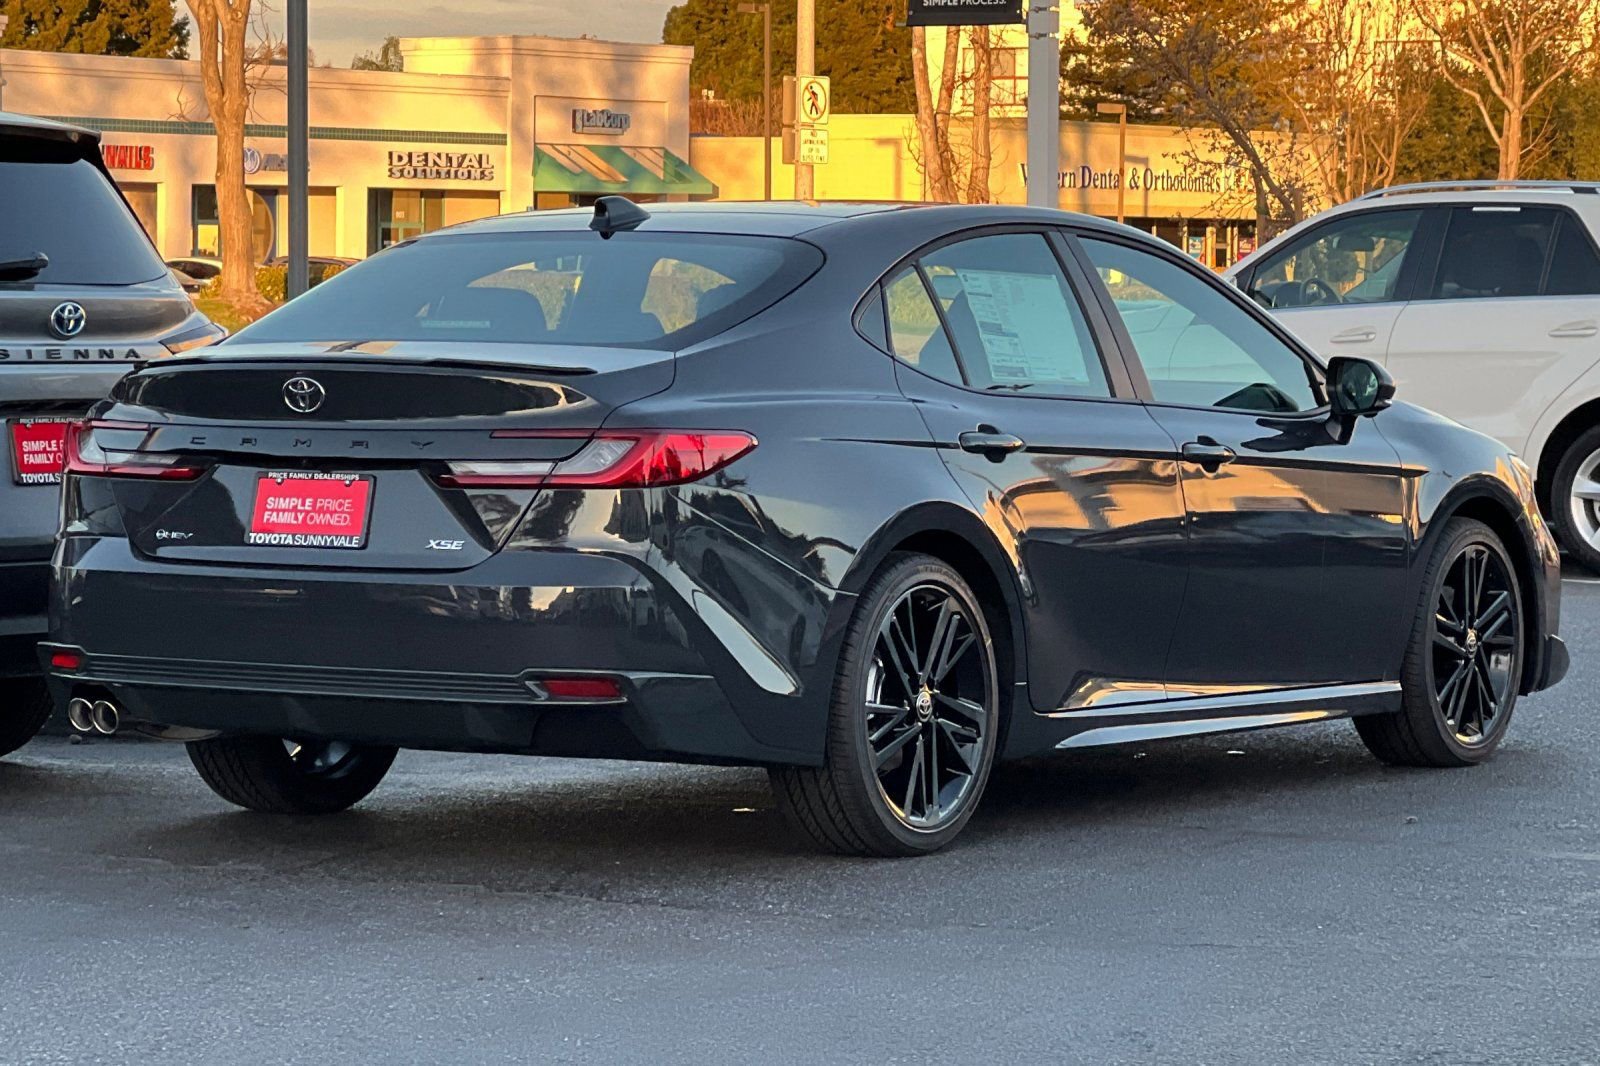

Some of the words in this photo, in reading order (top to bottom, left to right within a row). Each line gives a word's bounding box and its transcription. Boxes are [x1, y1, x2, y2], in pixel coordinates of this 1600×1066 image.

[583, 109, 631, 129] LabCorp
[102, 145, 154, 170] NAILS
[388, 151, 494, 169] DENTAL
[388, 167, 494, 181] SOLUTIONS
[1080, 165, 1121, 190] Denta
[1129, 167, 1140, 190] &
[0, 348, 141, 360] SIENNA
[22, 440, 58, 452] SIMPLE
[190, 436, 434, 450] CAMRY
[23, 453, 54, 465] FAMILY
[21, 473, 55, 483] TOYOTA
[268, 471, 287, 479] PRICE
[289, 472, 312, 480] FAMILY
[314, 473, 360, 481] DEALERSHIPS
[266, 496, 314, 510] SIMPLE
[263, 511, 305, 524] FAMILY
[424, 539, 465, 550] XSE
